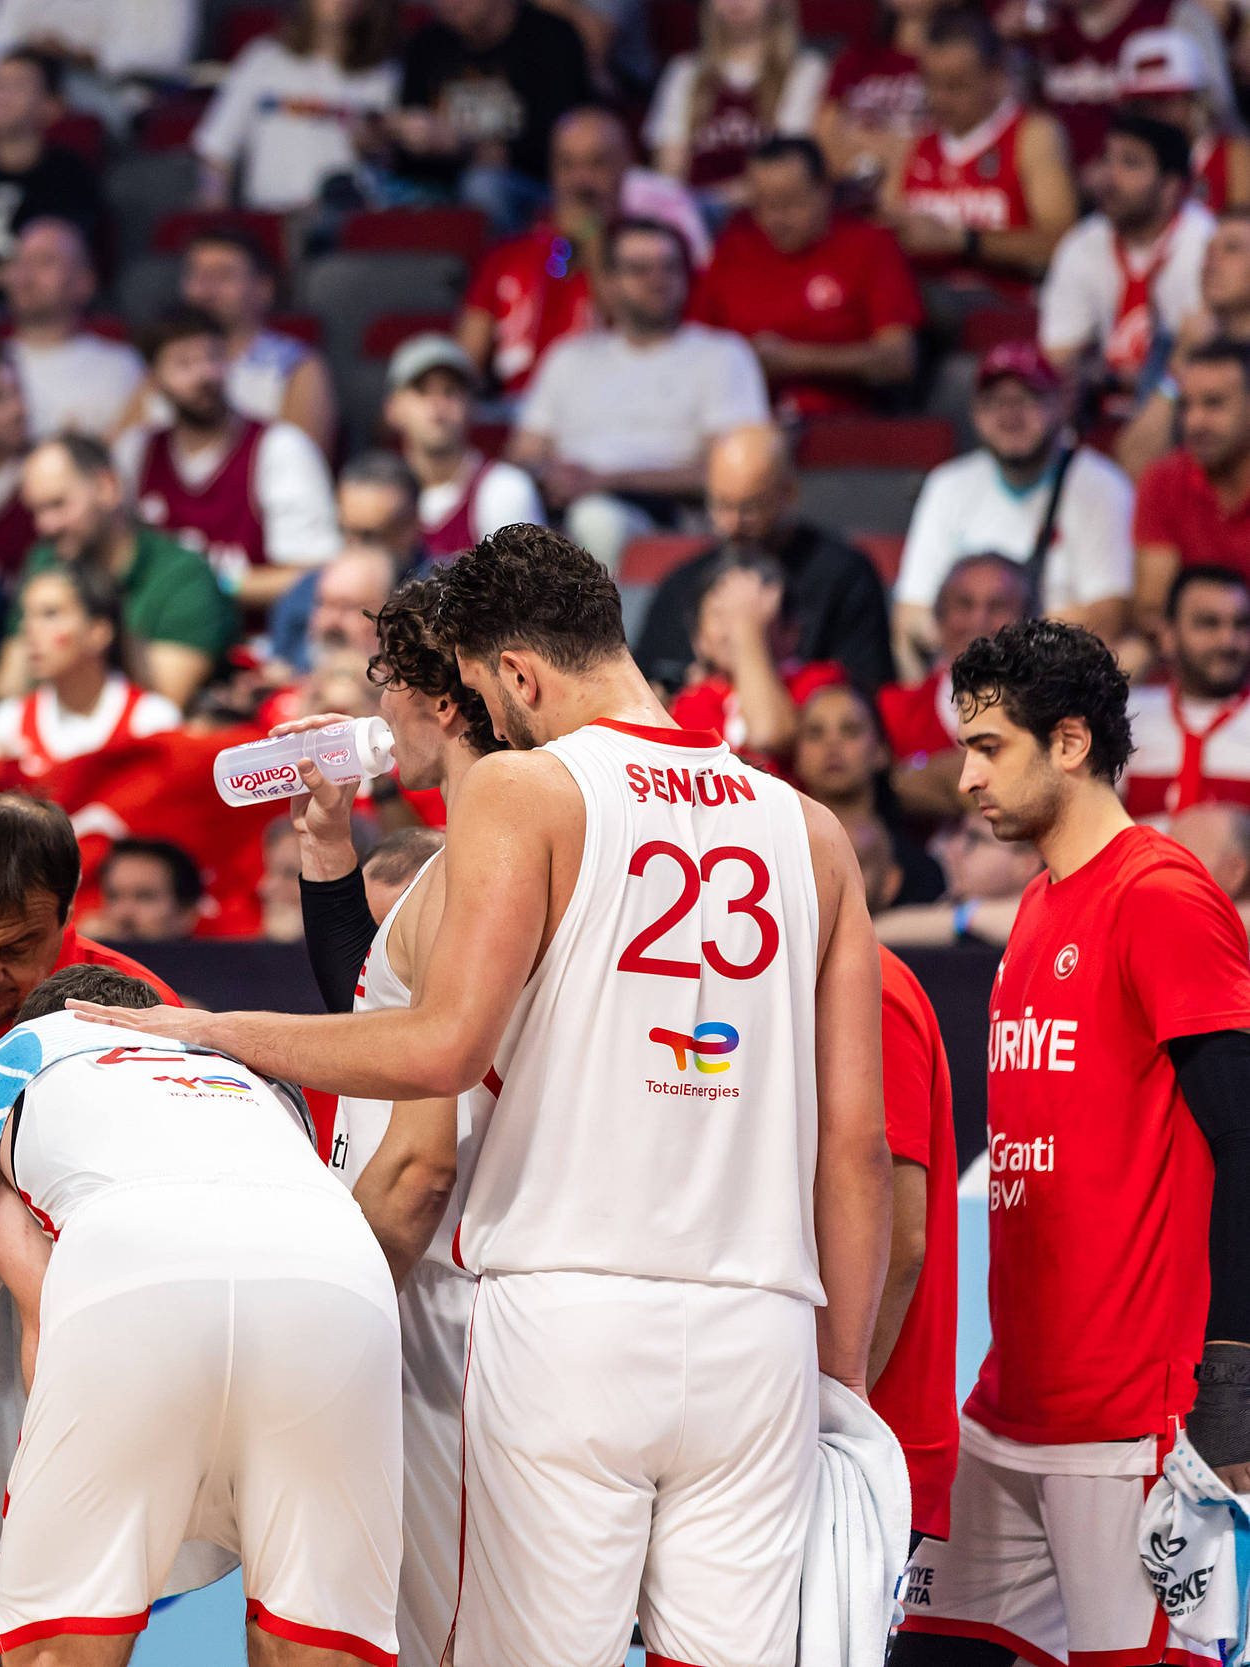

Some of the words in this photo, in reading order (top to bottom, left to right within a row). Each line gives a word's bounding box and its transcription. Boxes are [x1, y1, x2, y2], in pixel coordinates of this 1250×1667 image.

[625, 763, 757, 808] ŞENÜN
[616, 839, 780, 981] 23
[645, 1079, 740, 1101] TotalEnergies
[330, 1133, 349, 1170] ti
